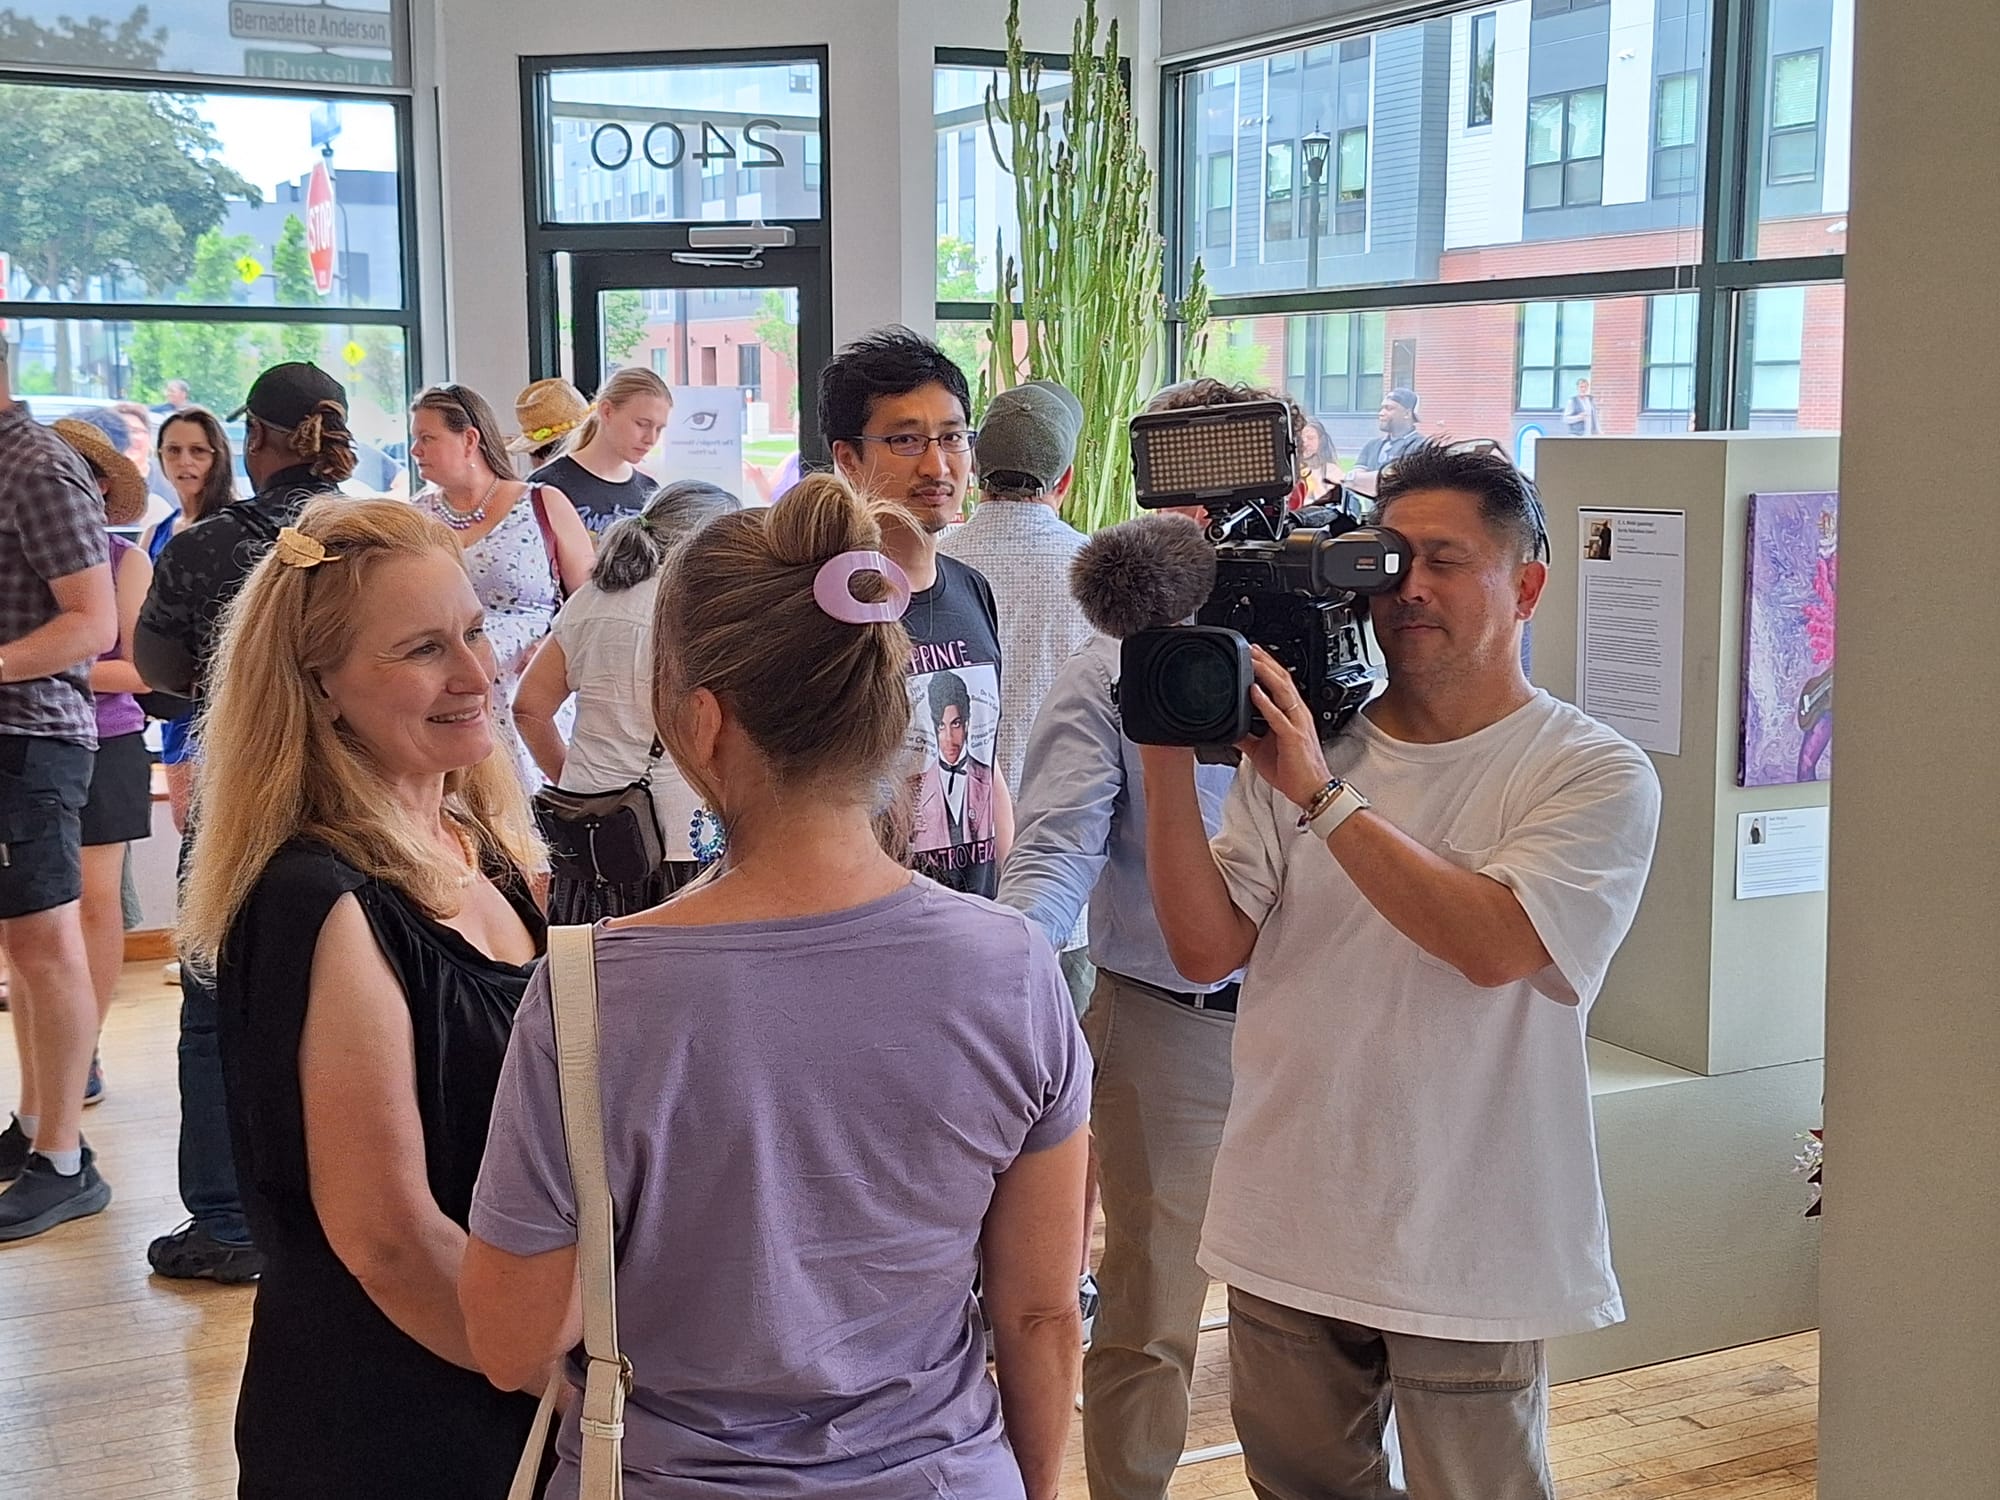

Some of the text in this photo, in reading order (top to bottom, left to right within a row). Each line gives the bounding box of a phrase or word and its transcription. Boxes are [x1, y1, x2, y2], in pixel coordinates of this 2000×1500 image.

[234, 7, 386, 41] Bernadette Anderson
[250, 56, 264, 78] N
[273, 58, 360, 84] Russell
[309, 201, 332, 254] STOP
[910, 640, 972, 674] PRINCE
